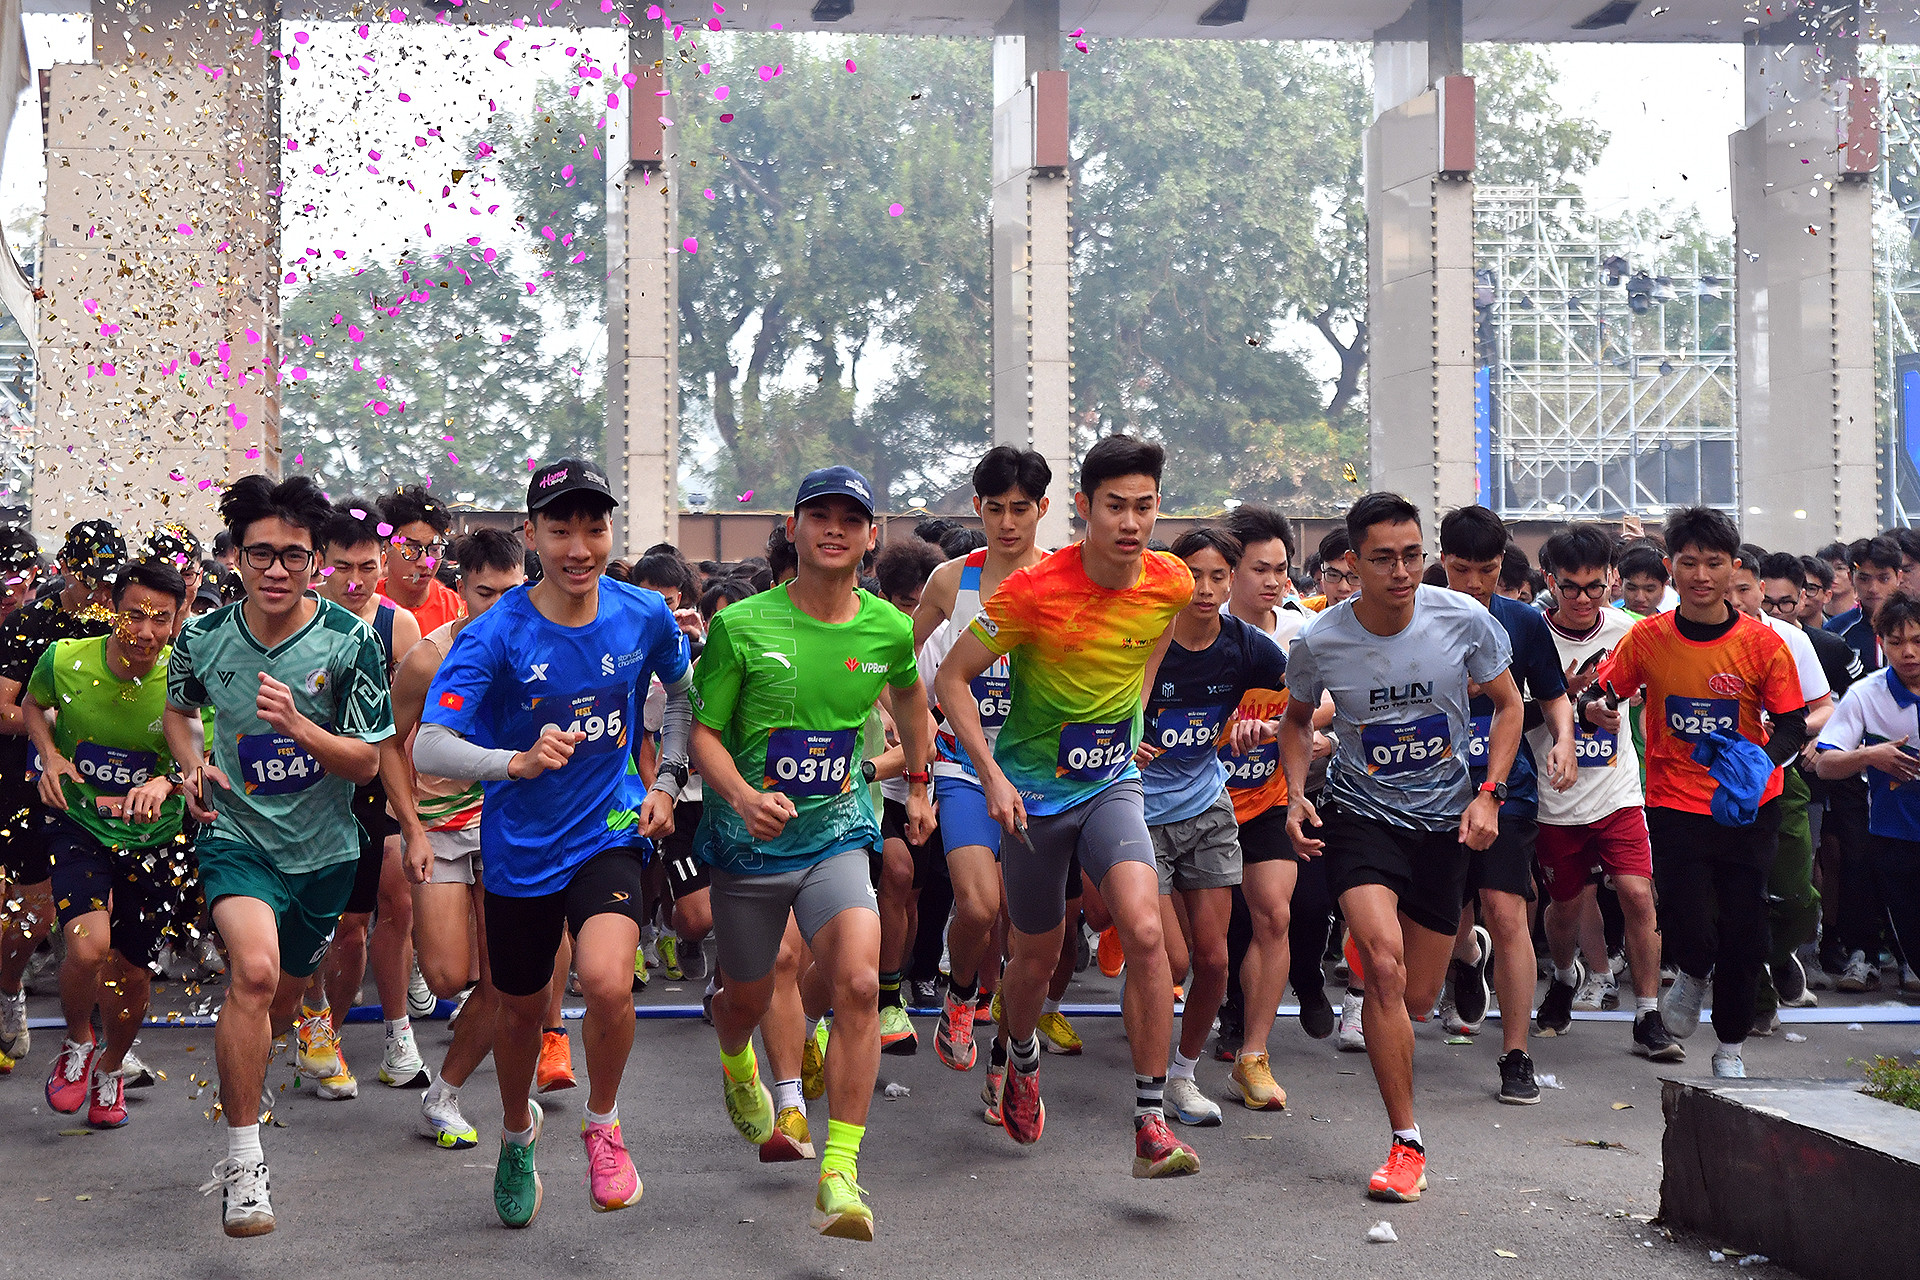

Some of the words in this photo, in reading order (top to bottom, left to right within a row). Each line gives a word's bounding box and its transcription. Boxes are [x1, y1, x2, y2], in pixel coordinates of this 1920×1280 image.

[1370, 681, 1433, 704] RUN
[1370, 704, 1389, 712] INTO
[1671, 713, 1733, 734] 0252
[1161, 722, 1219, 748] 0493
[277, 747, 296, 756] FEST
[809, 747, 828, 755] FEST
[1068, 742, 1125, 770] 0812
[1372, 736, 1444, 765] 0752
[1575, 740, 1613, 758] 505
[79, 759, 148, 788] 0656
[776, 756, 846, 783] 0318
[1222, 759, 1276, 780] 0498
